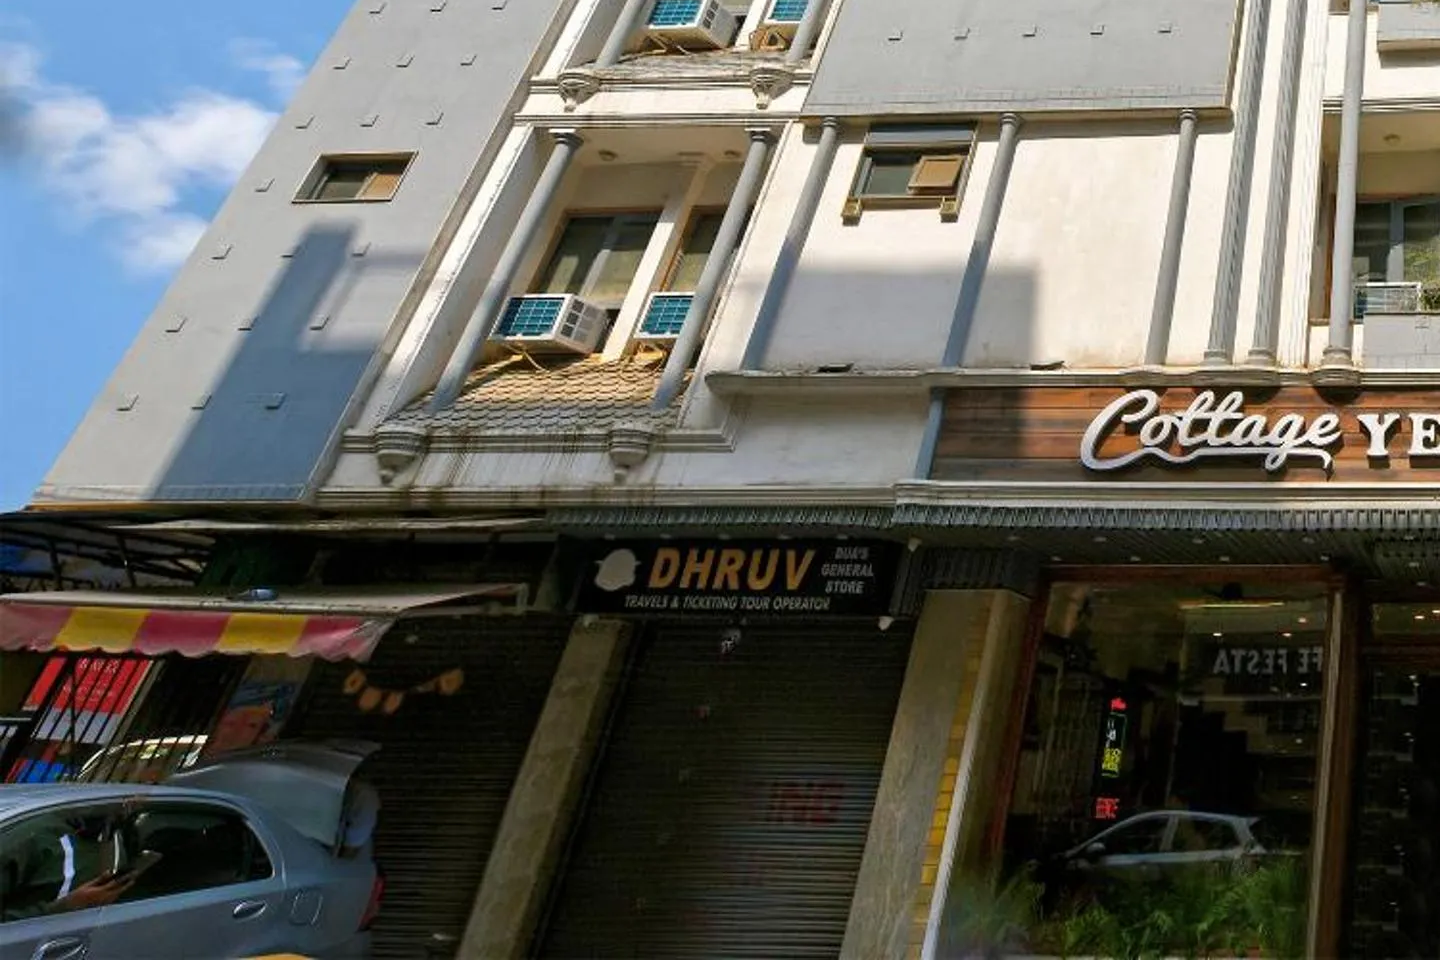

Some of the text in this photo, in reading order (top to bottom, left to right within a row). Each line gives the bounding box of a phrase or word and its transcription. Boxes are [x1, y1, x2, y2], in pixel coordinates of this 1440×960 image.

[1080, 389, 1342, 471] Cottage
[648, 547, 816, 590] DHRUV
[821, 563, 874, 577] GENERAL
[825, 580, 863, 593] STORE
[624, 595, 667, 608] TRAVELS
[683, 595, 737, 609] TICKETING
[739, 596, 769, 609] TOUR
[773, 596, 831, 610] OPERATOR
